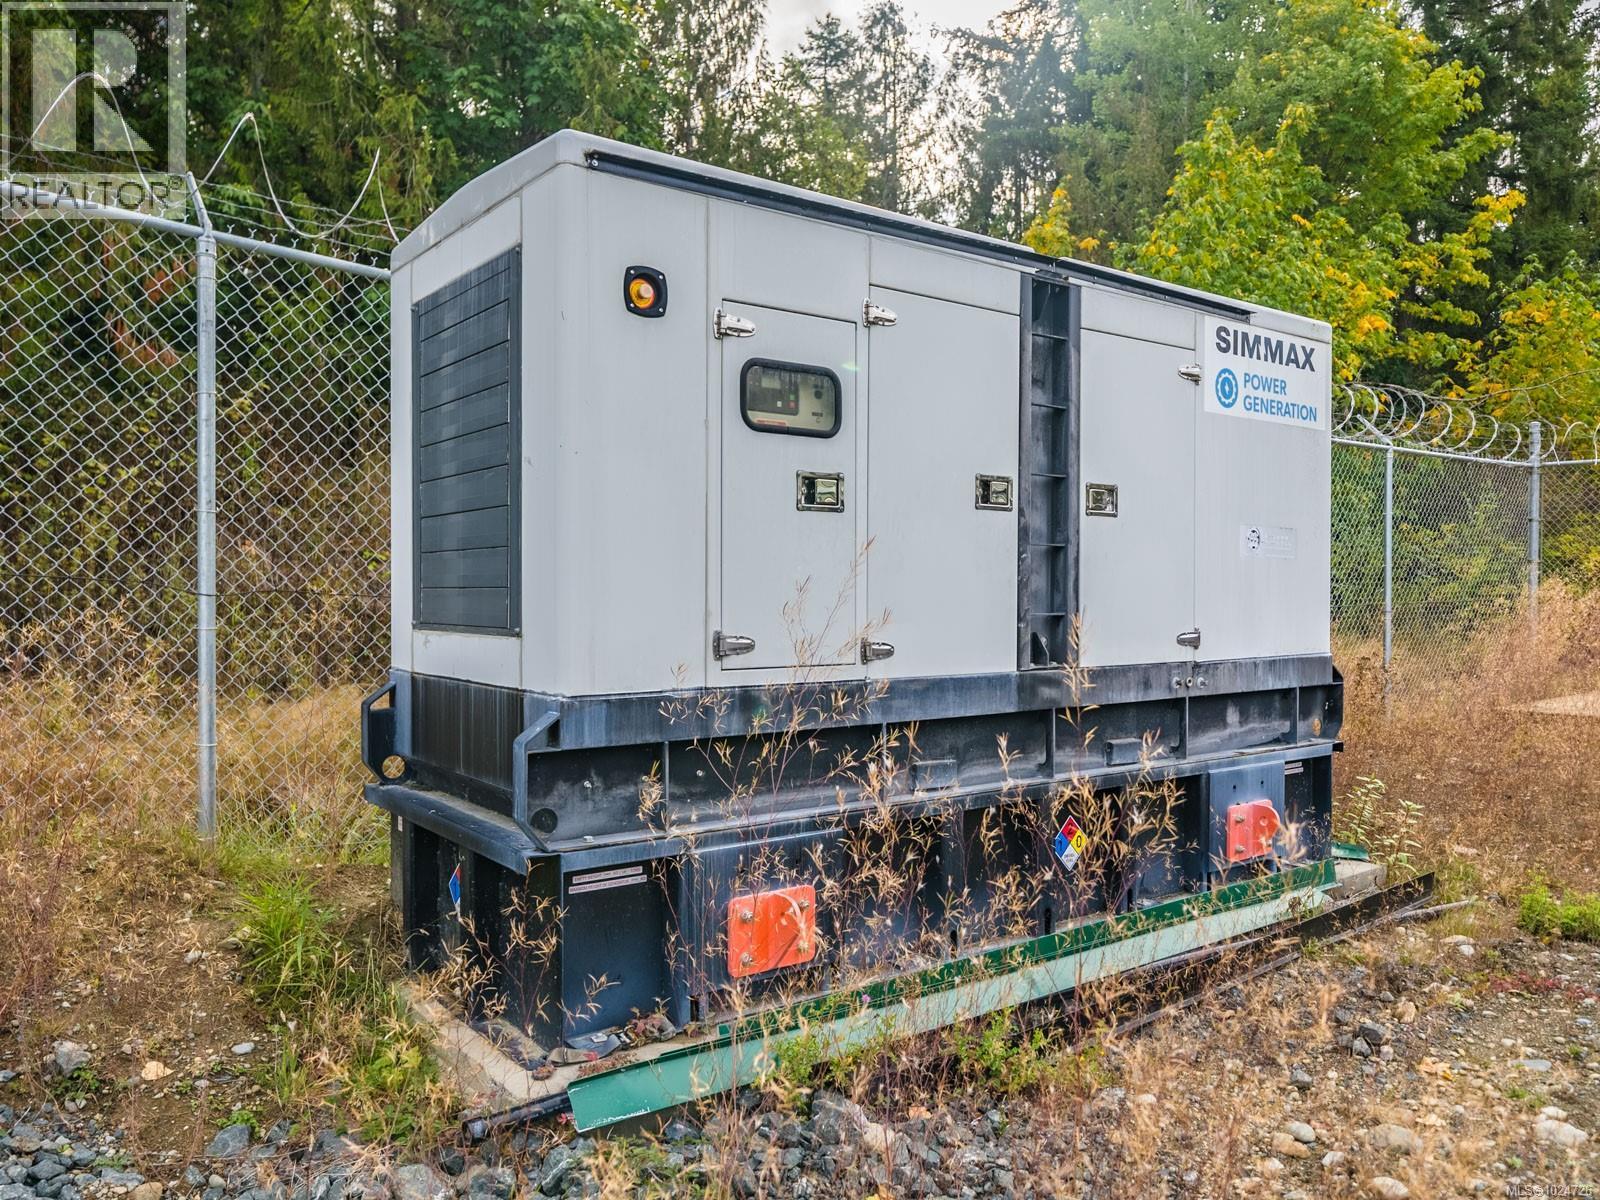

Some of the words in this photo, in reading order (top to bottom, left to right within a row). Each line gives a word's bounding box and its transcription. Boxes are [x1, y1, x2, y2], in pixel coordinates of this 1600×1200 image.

[1215, 325, 1316, 373] SIMMAX
[1243, 372, 1287, 396] POWER
[1243, 395, 1317, 422] GENERATION
